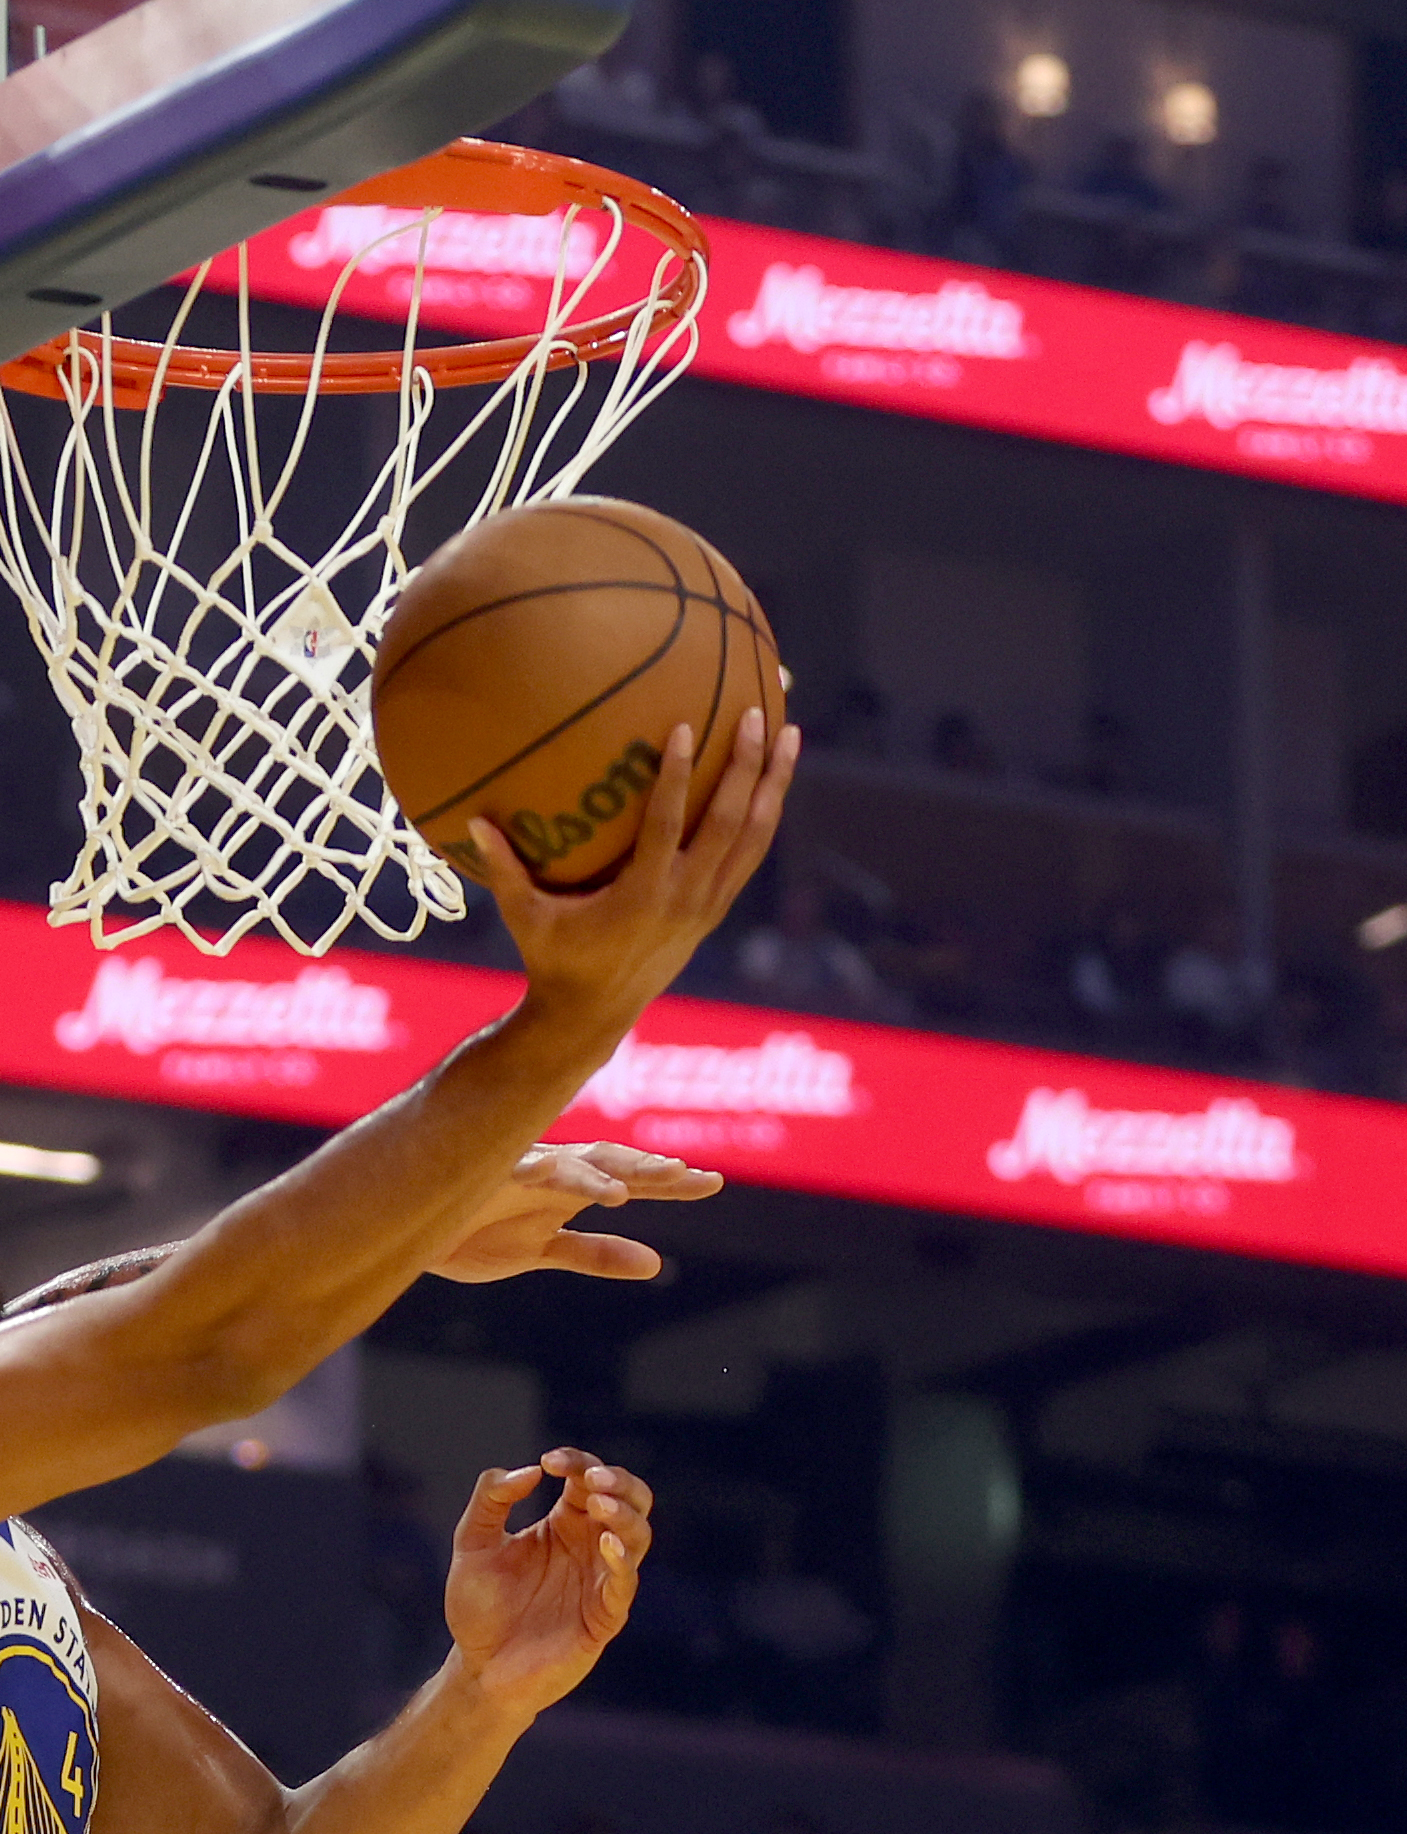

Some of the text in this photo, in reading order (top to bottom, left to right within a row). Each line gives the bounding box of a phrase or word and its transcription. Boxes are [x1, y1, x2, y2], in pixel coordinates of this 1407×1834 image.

[1149, 343, 1407, 433] Mezzett
[56, 957, 390, 1053] Mezzetta
[60, 1731, 84, 1818] 4
